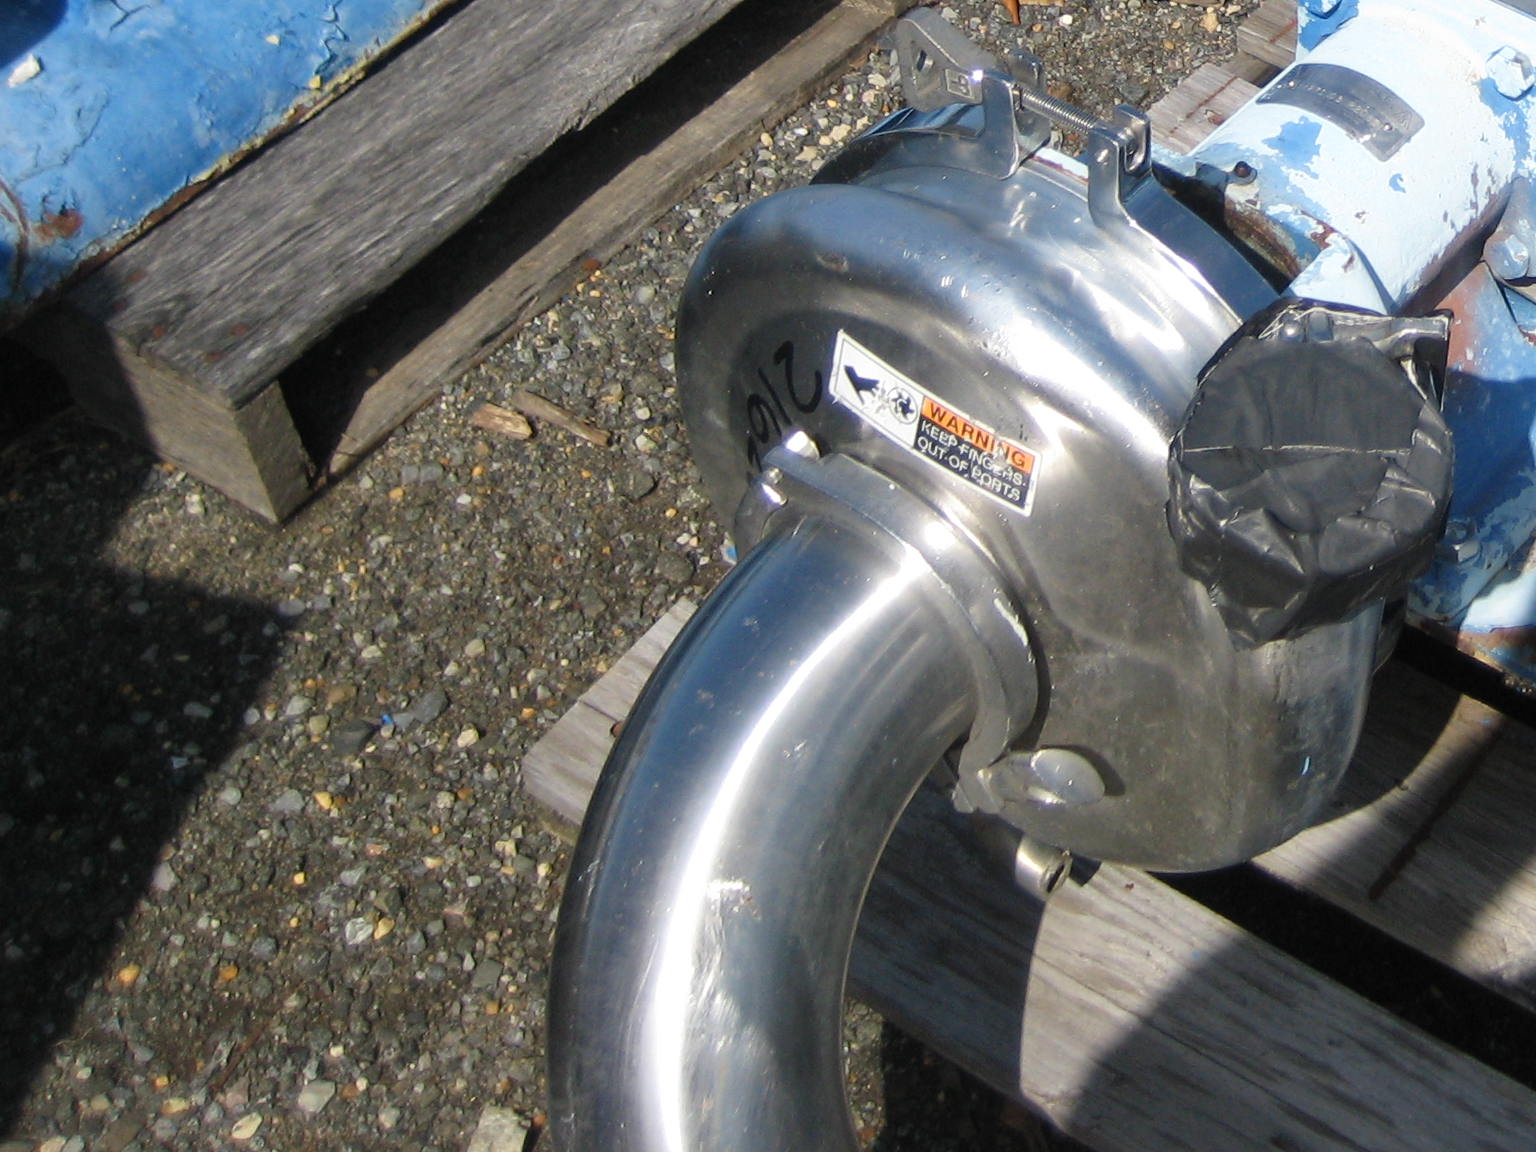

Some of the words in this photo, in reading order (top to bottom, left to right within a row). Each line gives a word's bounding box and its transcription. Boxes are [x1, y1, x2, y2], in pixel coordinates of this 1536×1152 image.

[921, 420, 958, 448] KEEP
[930, 402, 1026, 467] WARNING
[917, 436, 946, 460] OUT
[948, 455, 969, 472] OF
[971, 465, 1021, 502] PORTS
